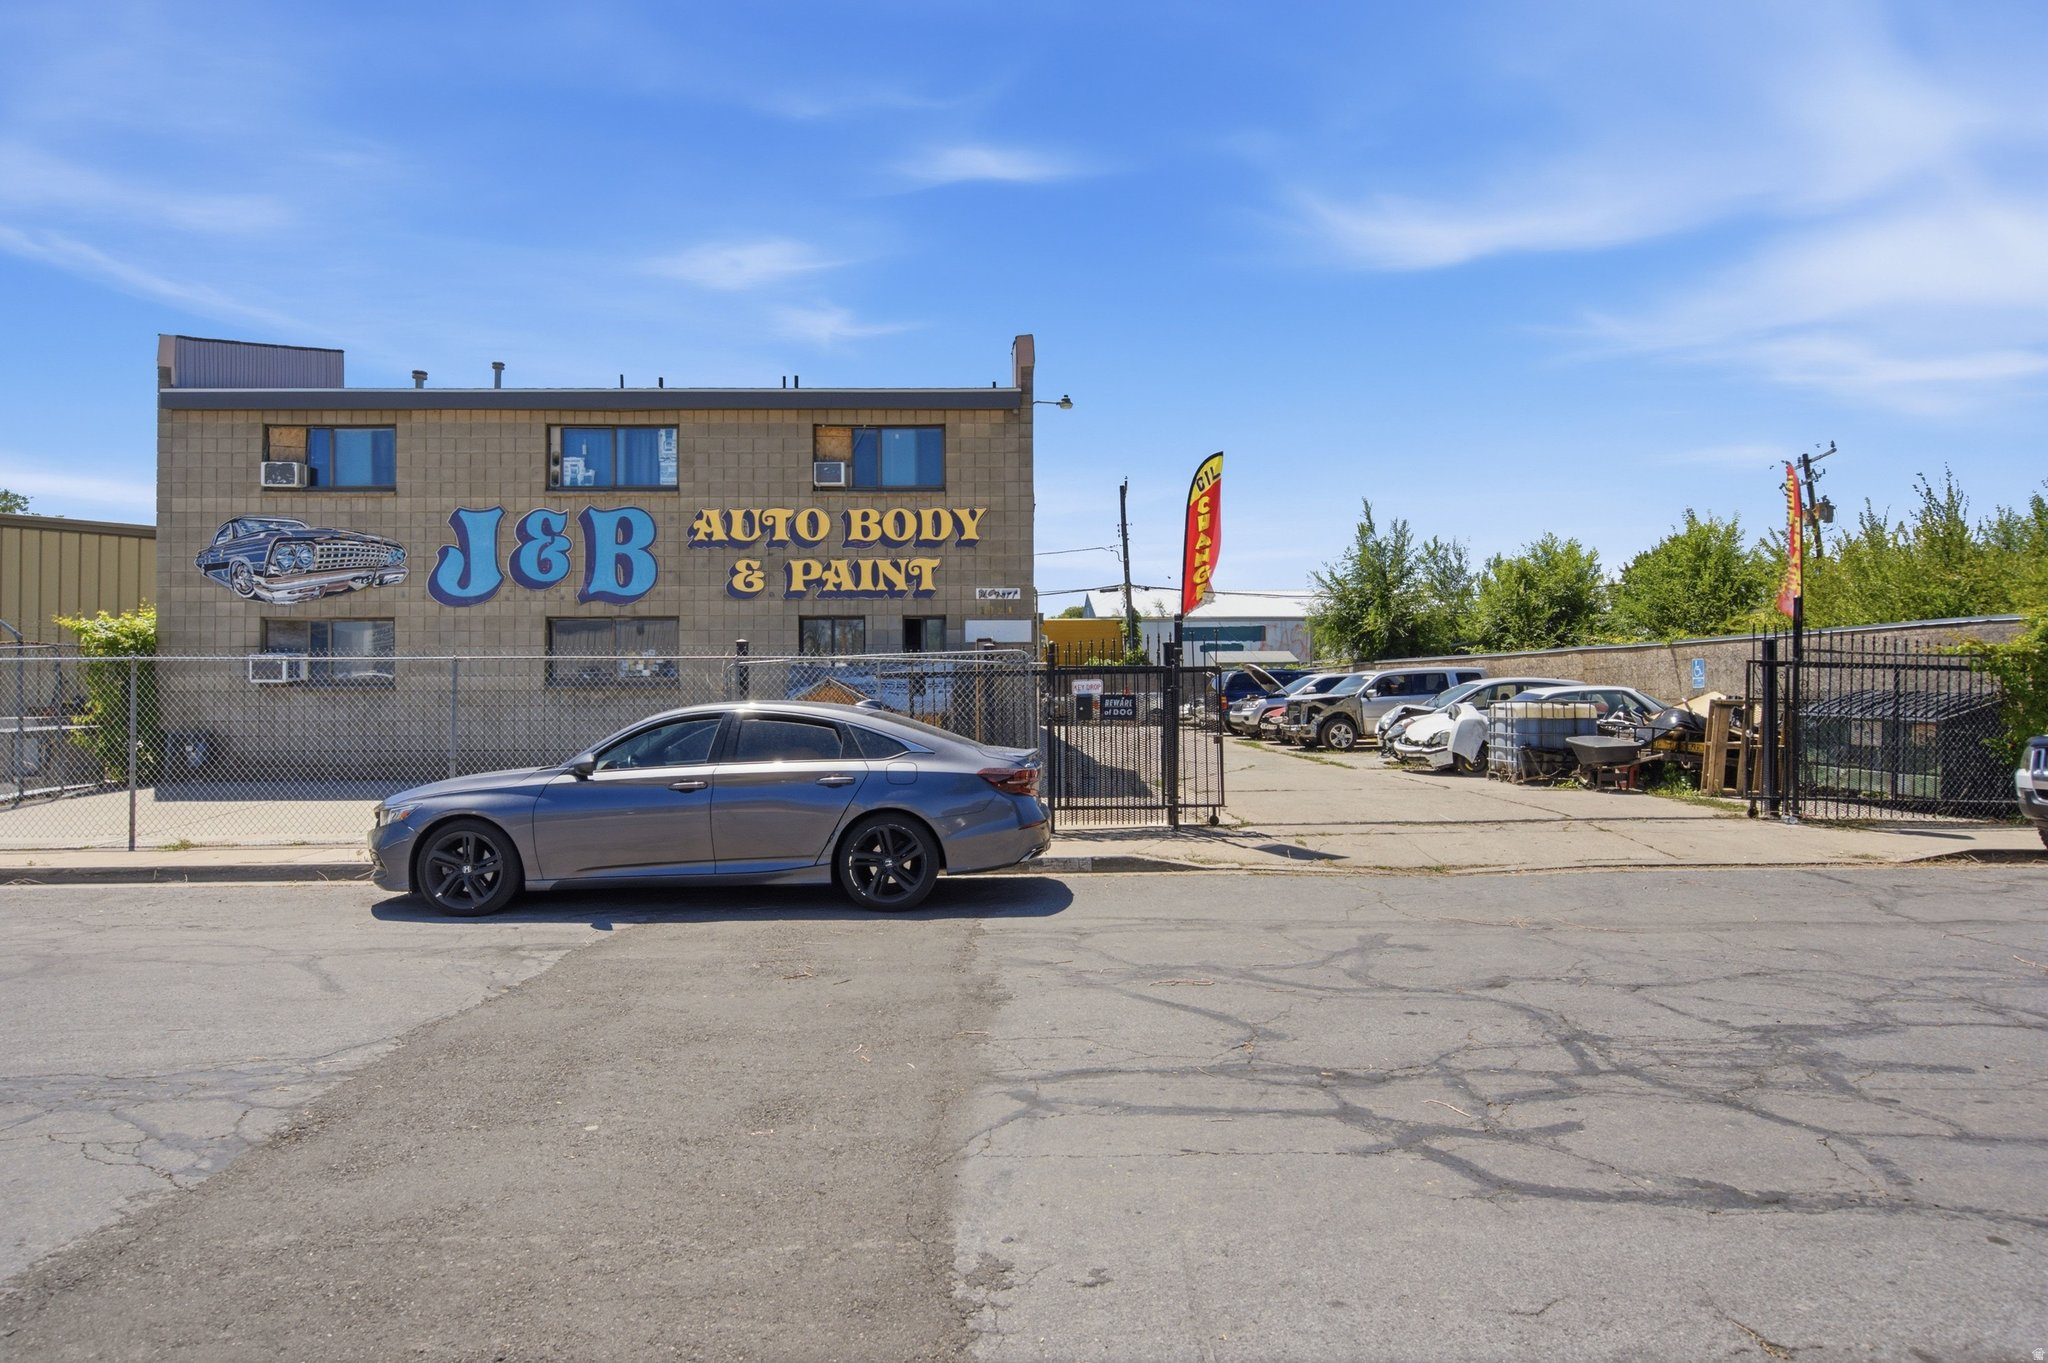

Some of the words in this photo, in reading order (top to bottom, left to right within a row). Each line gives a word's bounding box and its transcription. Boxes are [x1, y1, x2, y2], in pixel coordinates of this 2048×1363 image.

[1196, 467, 1221, 492] OIL
[687, 507, 831, 549] AUTO
[841, 507, 988, 549] BODY
[427, 504, 659, 608] J&B
[726, 558, 766, 600] &
[783, 557, 941, 600] PAINT
[1104, 699, 1133, 708] BEWARE
[1104, 708, 1112, 716] of
[1113, 708, 1133, 716] DOG
